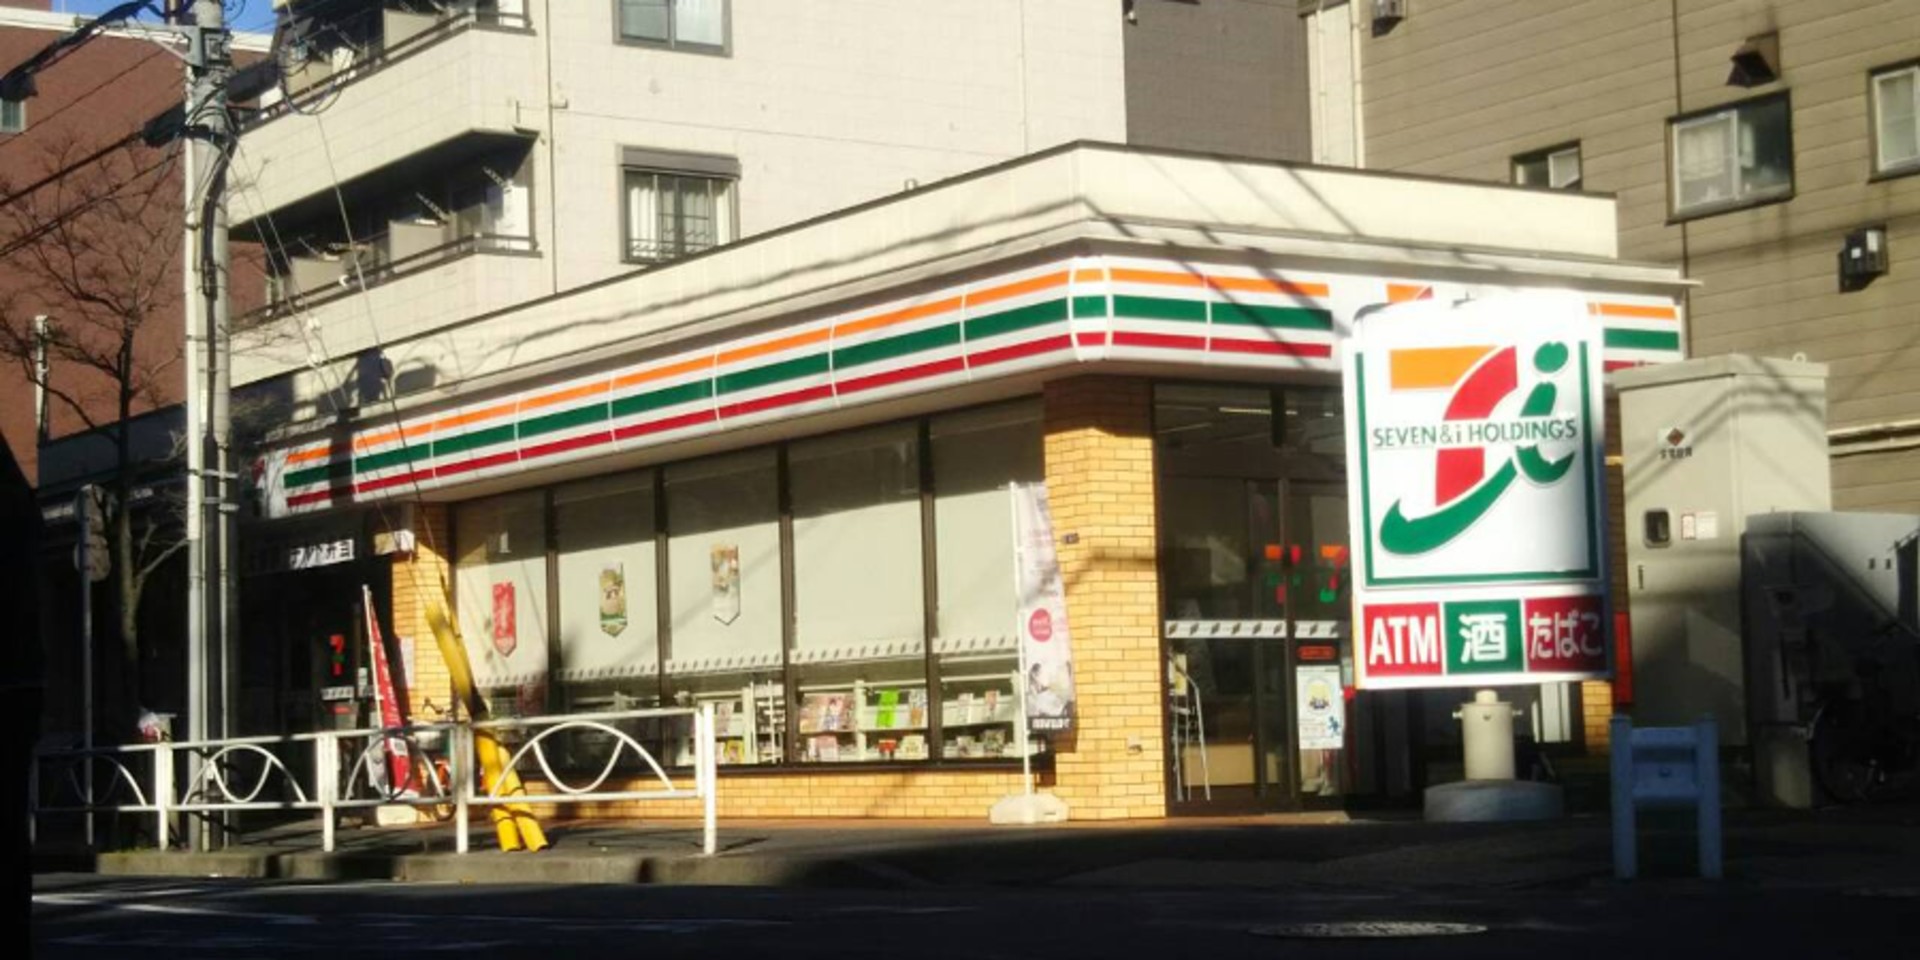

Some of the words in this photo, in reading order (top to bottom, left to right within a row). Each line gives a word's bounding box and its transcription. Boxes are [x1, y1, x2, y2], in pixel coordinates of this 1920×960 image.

[1468, 418, 1578, 443] HOLDINGS
[1368, 615, 1439, 666] ATM
[1458, 612, 1508, 664] 酒
[1529, 609, 1603, 661] たばこ
